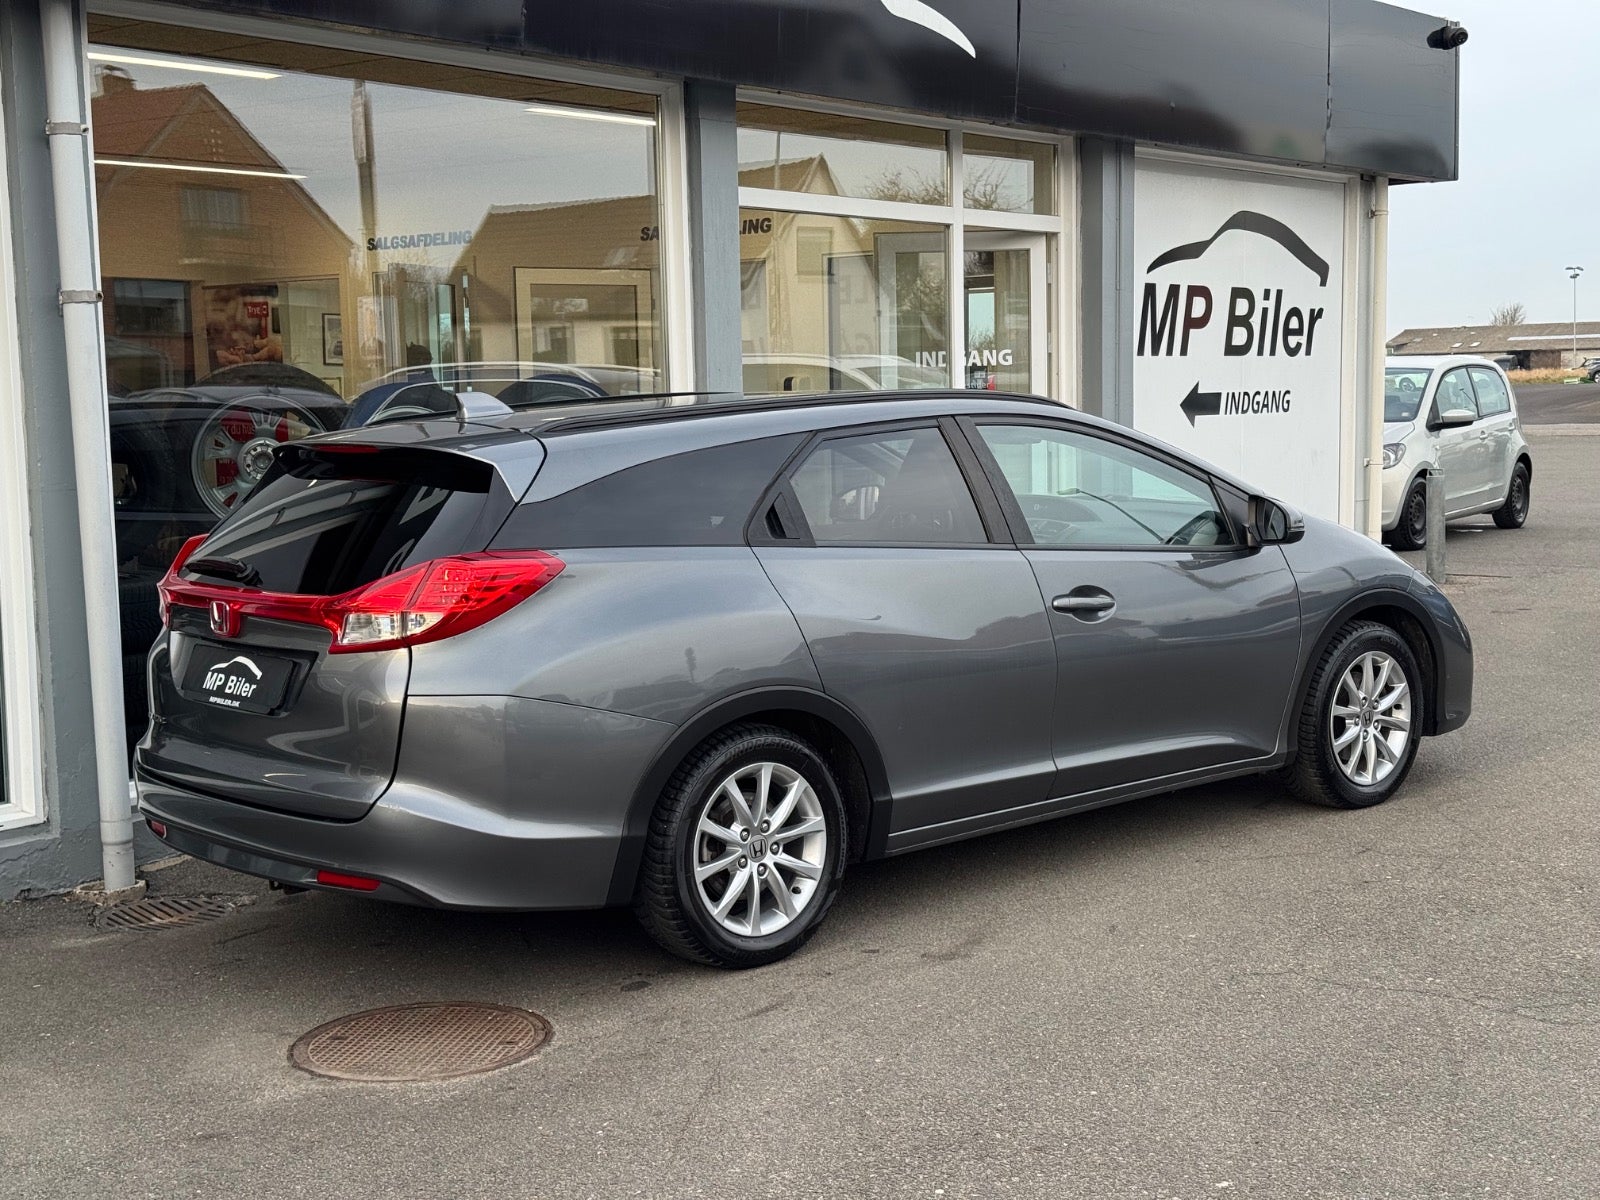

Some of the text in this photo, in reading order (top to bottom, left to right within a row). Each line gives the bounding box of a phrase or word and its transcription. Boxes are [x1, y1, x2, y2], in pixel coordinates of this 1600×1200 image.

[367, 230, 472, 251] SALGSAFDELING
[1136, 282, 1324, 358] MP Biler
[1224, 390, 1291, 415] INDGANG
[202, 671, 257, 698] MP Biler
